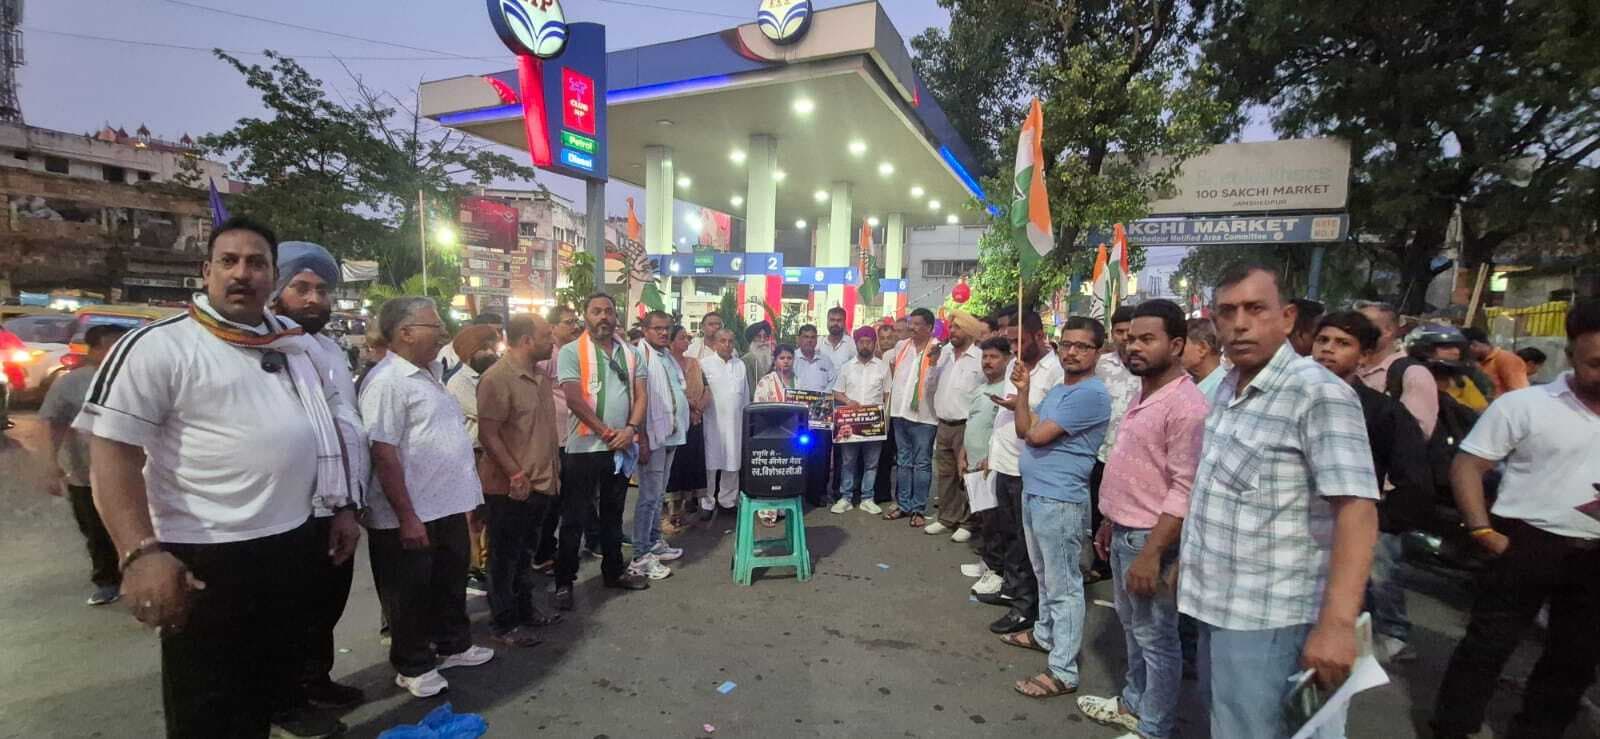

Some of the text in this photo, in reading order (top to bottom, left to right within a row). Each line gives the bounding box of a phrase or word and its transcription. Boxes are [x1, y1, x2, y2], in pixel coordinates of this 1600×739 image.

[569, 136, 592, 150] Petrol
[568, 153, 592, 168] Diesel
[1196, 189, 1217, 199] 100
[1221, 187, 1269, 199] SAKCHI
[1273, 184, 1330, 196] MARKET
[1193, 218, 1299, 233] MARKET
[1170, 234, 1200, 242] Notified
[1223, 233, 1267, 241] Committee
[767, 257, 778, 270] 2
[845, 269, 853, 281] 4
